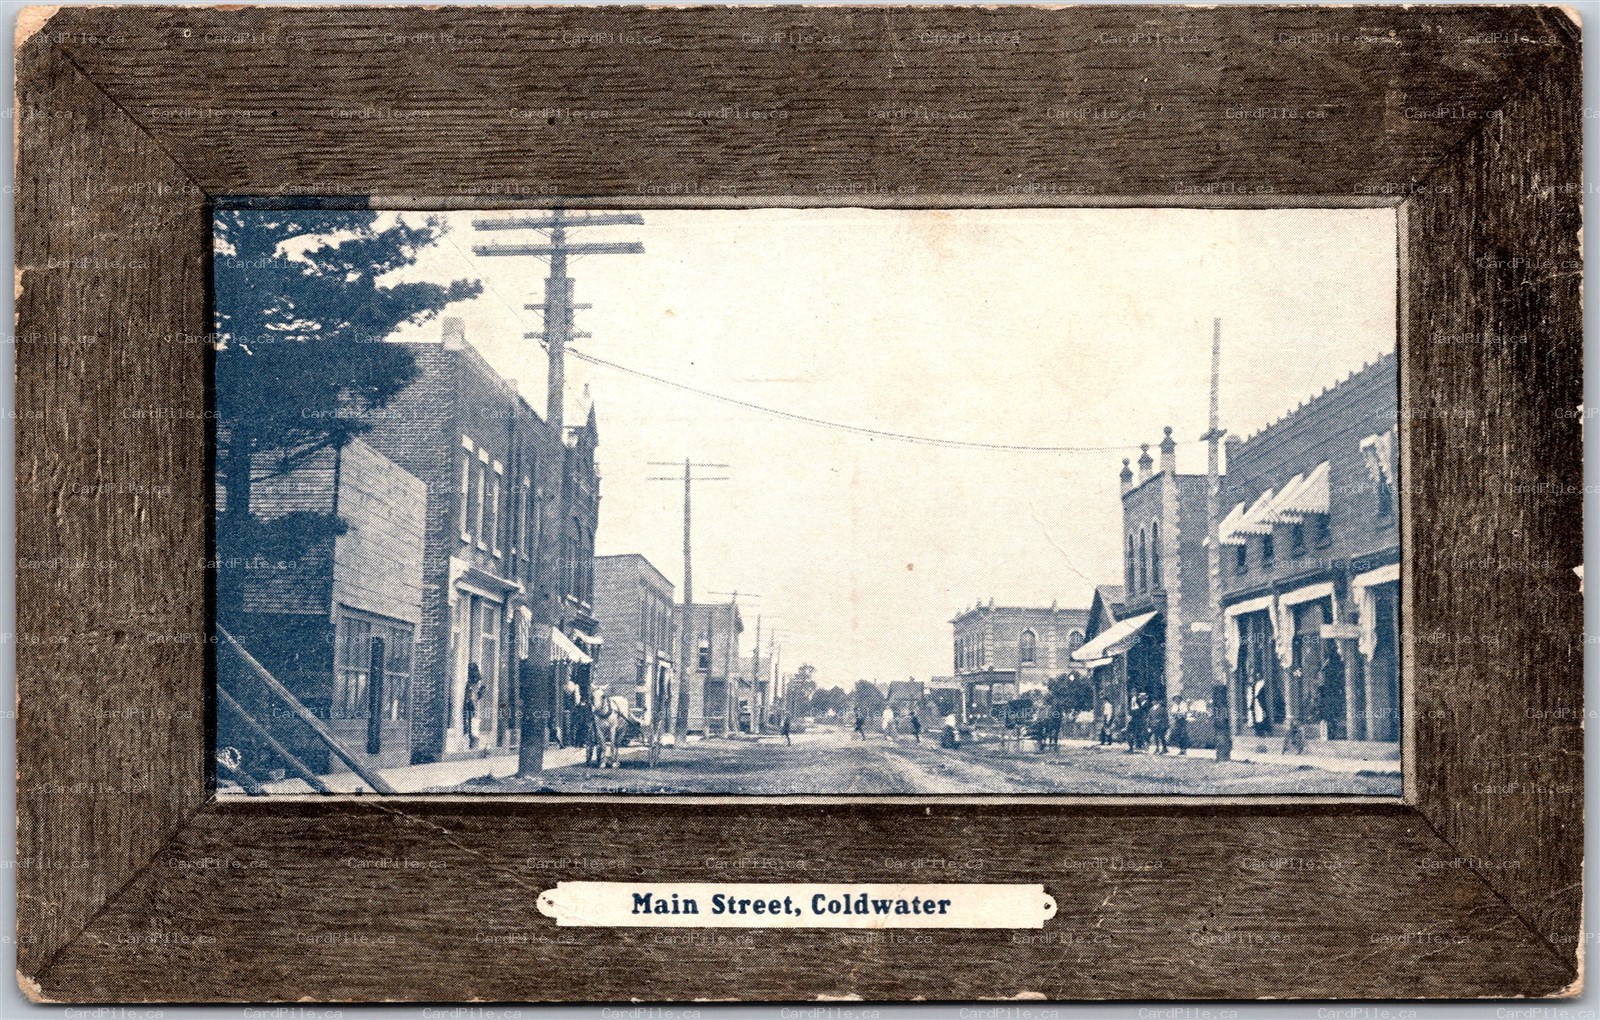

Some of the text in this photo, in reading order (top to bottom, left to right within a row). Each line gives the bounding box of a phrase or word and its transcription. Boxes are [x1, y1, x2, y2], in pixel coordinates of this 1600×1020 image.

[631, 892, 952, 917] Main Street, Coldwater
